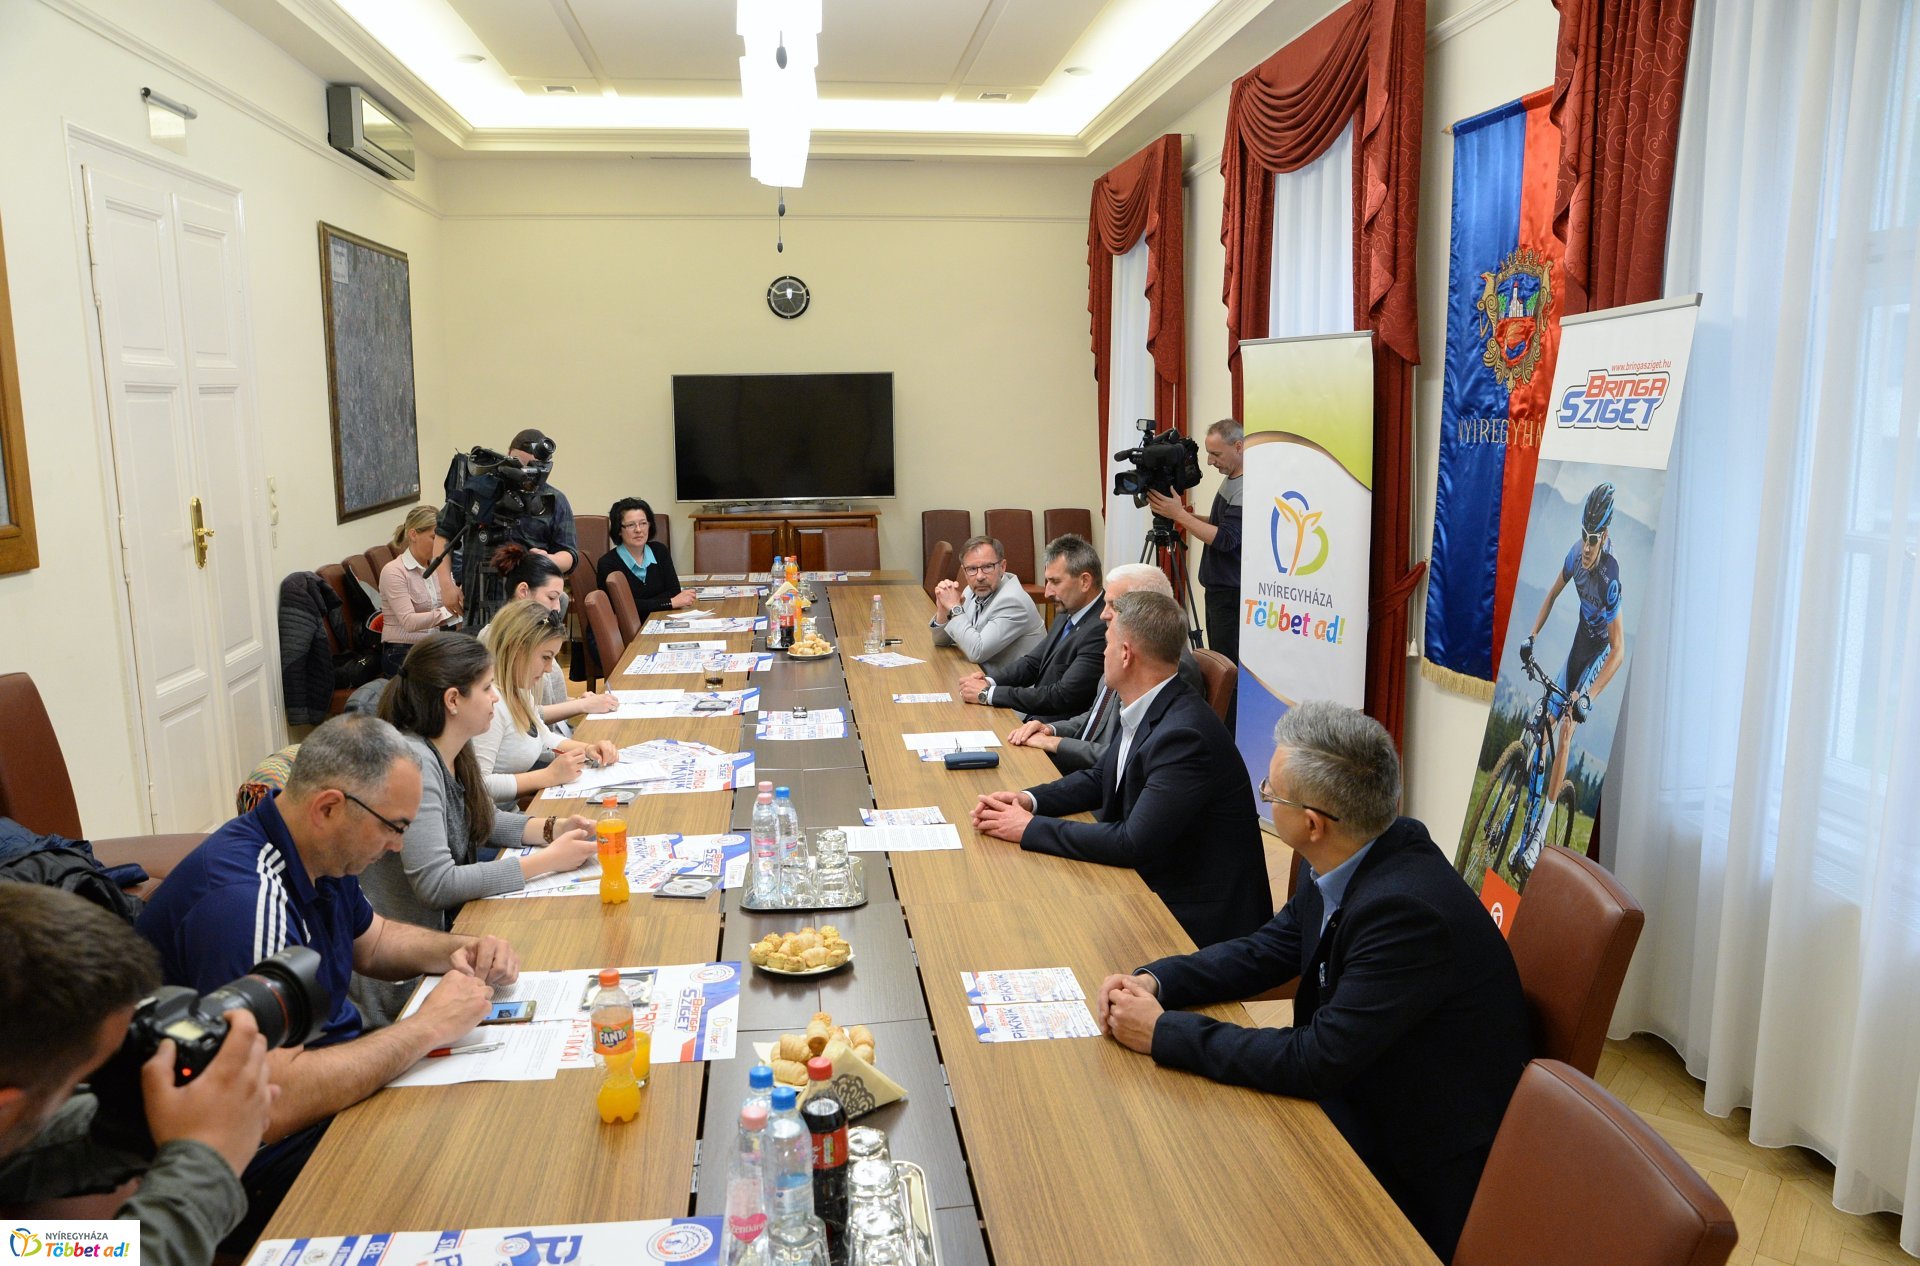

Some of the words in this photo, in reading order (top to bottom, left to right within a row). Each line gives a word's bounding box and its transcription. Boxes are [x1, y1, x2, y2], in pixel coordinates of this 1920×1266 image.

[1611, 359, 1672, 372] www.bringasziget.hu
[1585, 375, 1668, 402] BRINGA
[1560, 391, 1661, 425] SZIGET
[1258, 581, 1333, 608] NYÍREGYHÁZA
[1244, 598, 1311, 637] Többet
[1314, 614, 1346, 645] ad!
[677, 988, 697, 1031] SZIGET
[599, 1030, 628, 1044] FANTA
